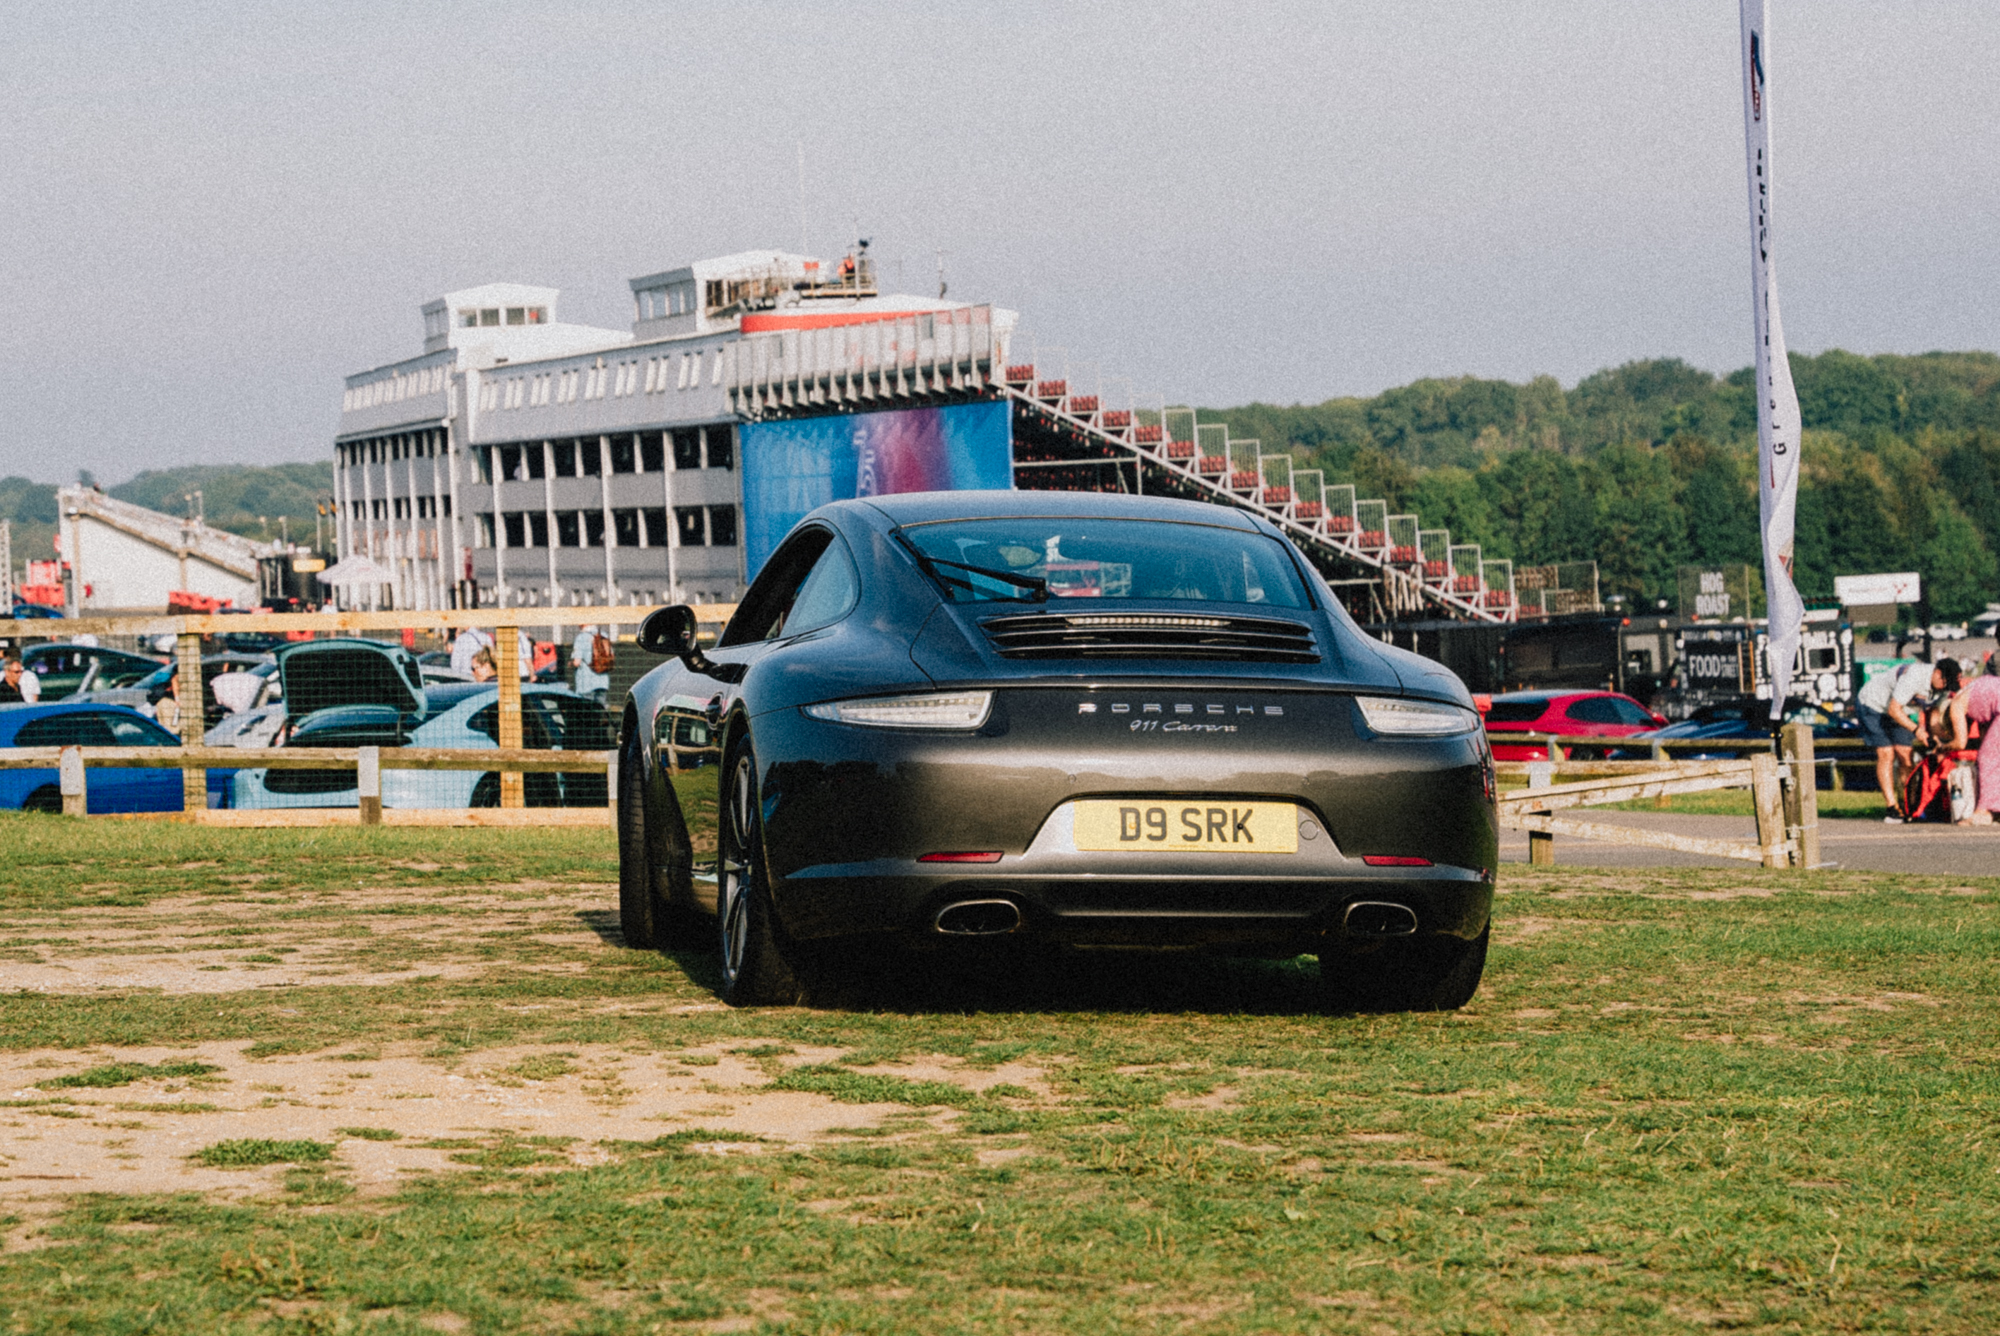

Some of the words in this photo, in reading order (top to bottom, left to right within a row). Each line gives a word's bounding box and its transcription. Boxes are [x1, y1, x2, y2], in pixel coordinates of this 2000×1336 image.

[1700, 571, 1724, 594] HOG
[1695, 593, 1731, 616] ROAST
[1689, 654, 1721, 678] FOOD
[1078, 703, 1284, 716] PORSCHE
[1129, 719, 1159, 732] 911
[1162, 720, 1239, 732] Carrera
[1119, 806, 1168, 842] D9
[1180, 807, 1254, 844] SRK
